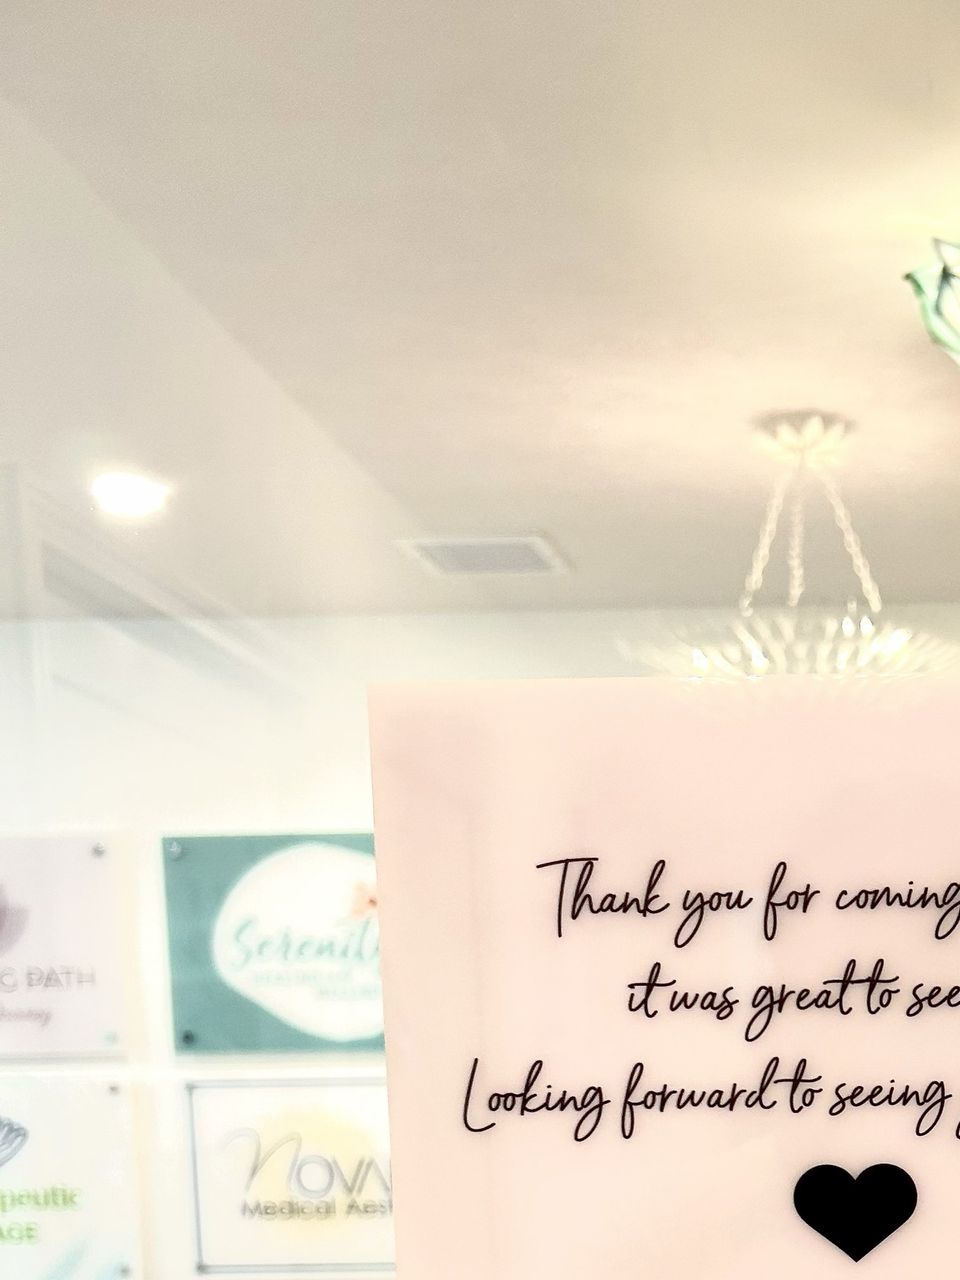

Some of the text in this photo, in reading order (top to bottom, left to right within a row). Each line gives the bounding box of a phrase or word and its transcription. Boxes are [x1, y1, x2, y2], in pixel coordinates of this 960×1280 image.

[535, 857, 670, 937] Thank
[673, 889, 754, 949] you
[763, 860, 821, 941] for
[25, 965, 97, 991] PATH
[626, 961, 677, 1018] it
[668, 986, 740, 1021] was
[744, 958, 860, 1042] great
[858, 957, 901, 1015] to
[462, 1057, 612, 1142] Looking
[621, 1056, 778, 1140] forward
[773, 1058, 824, 1115] to
[828, 1078, 953, 1137] seeing
[241, 1198, 337, 1222] Medical
